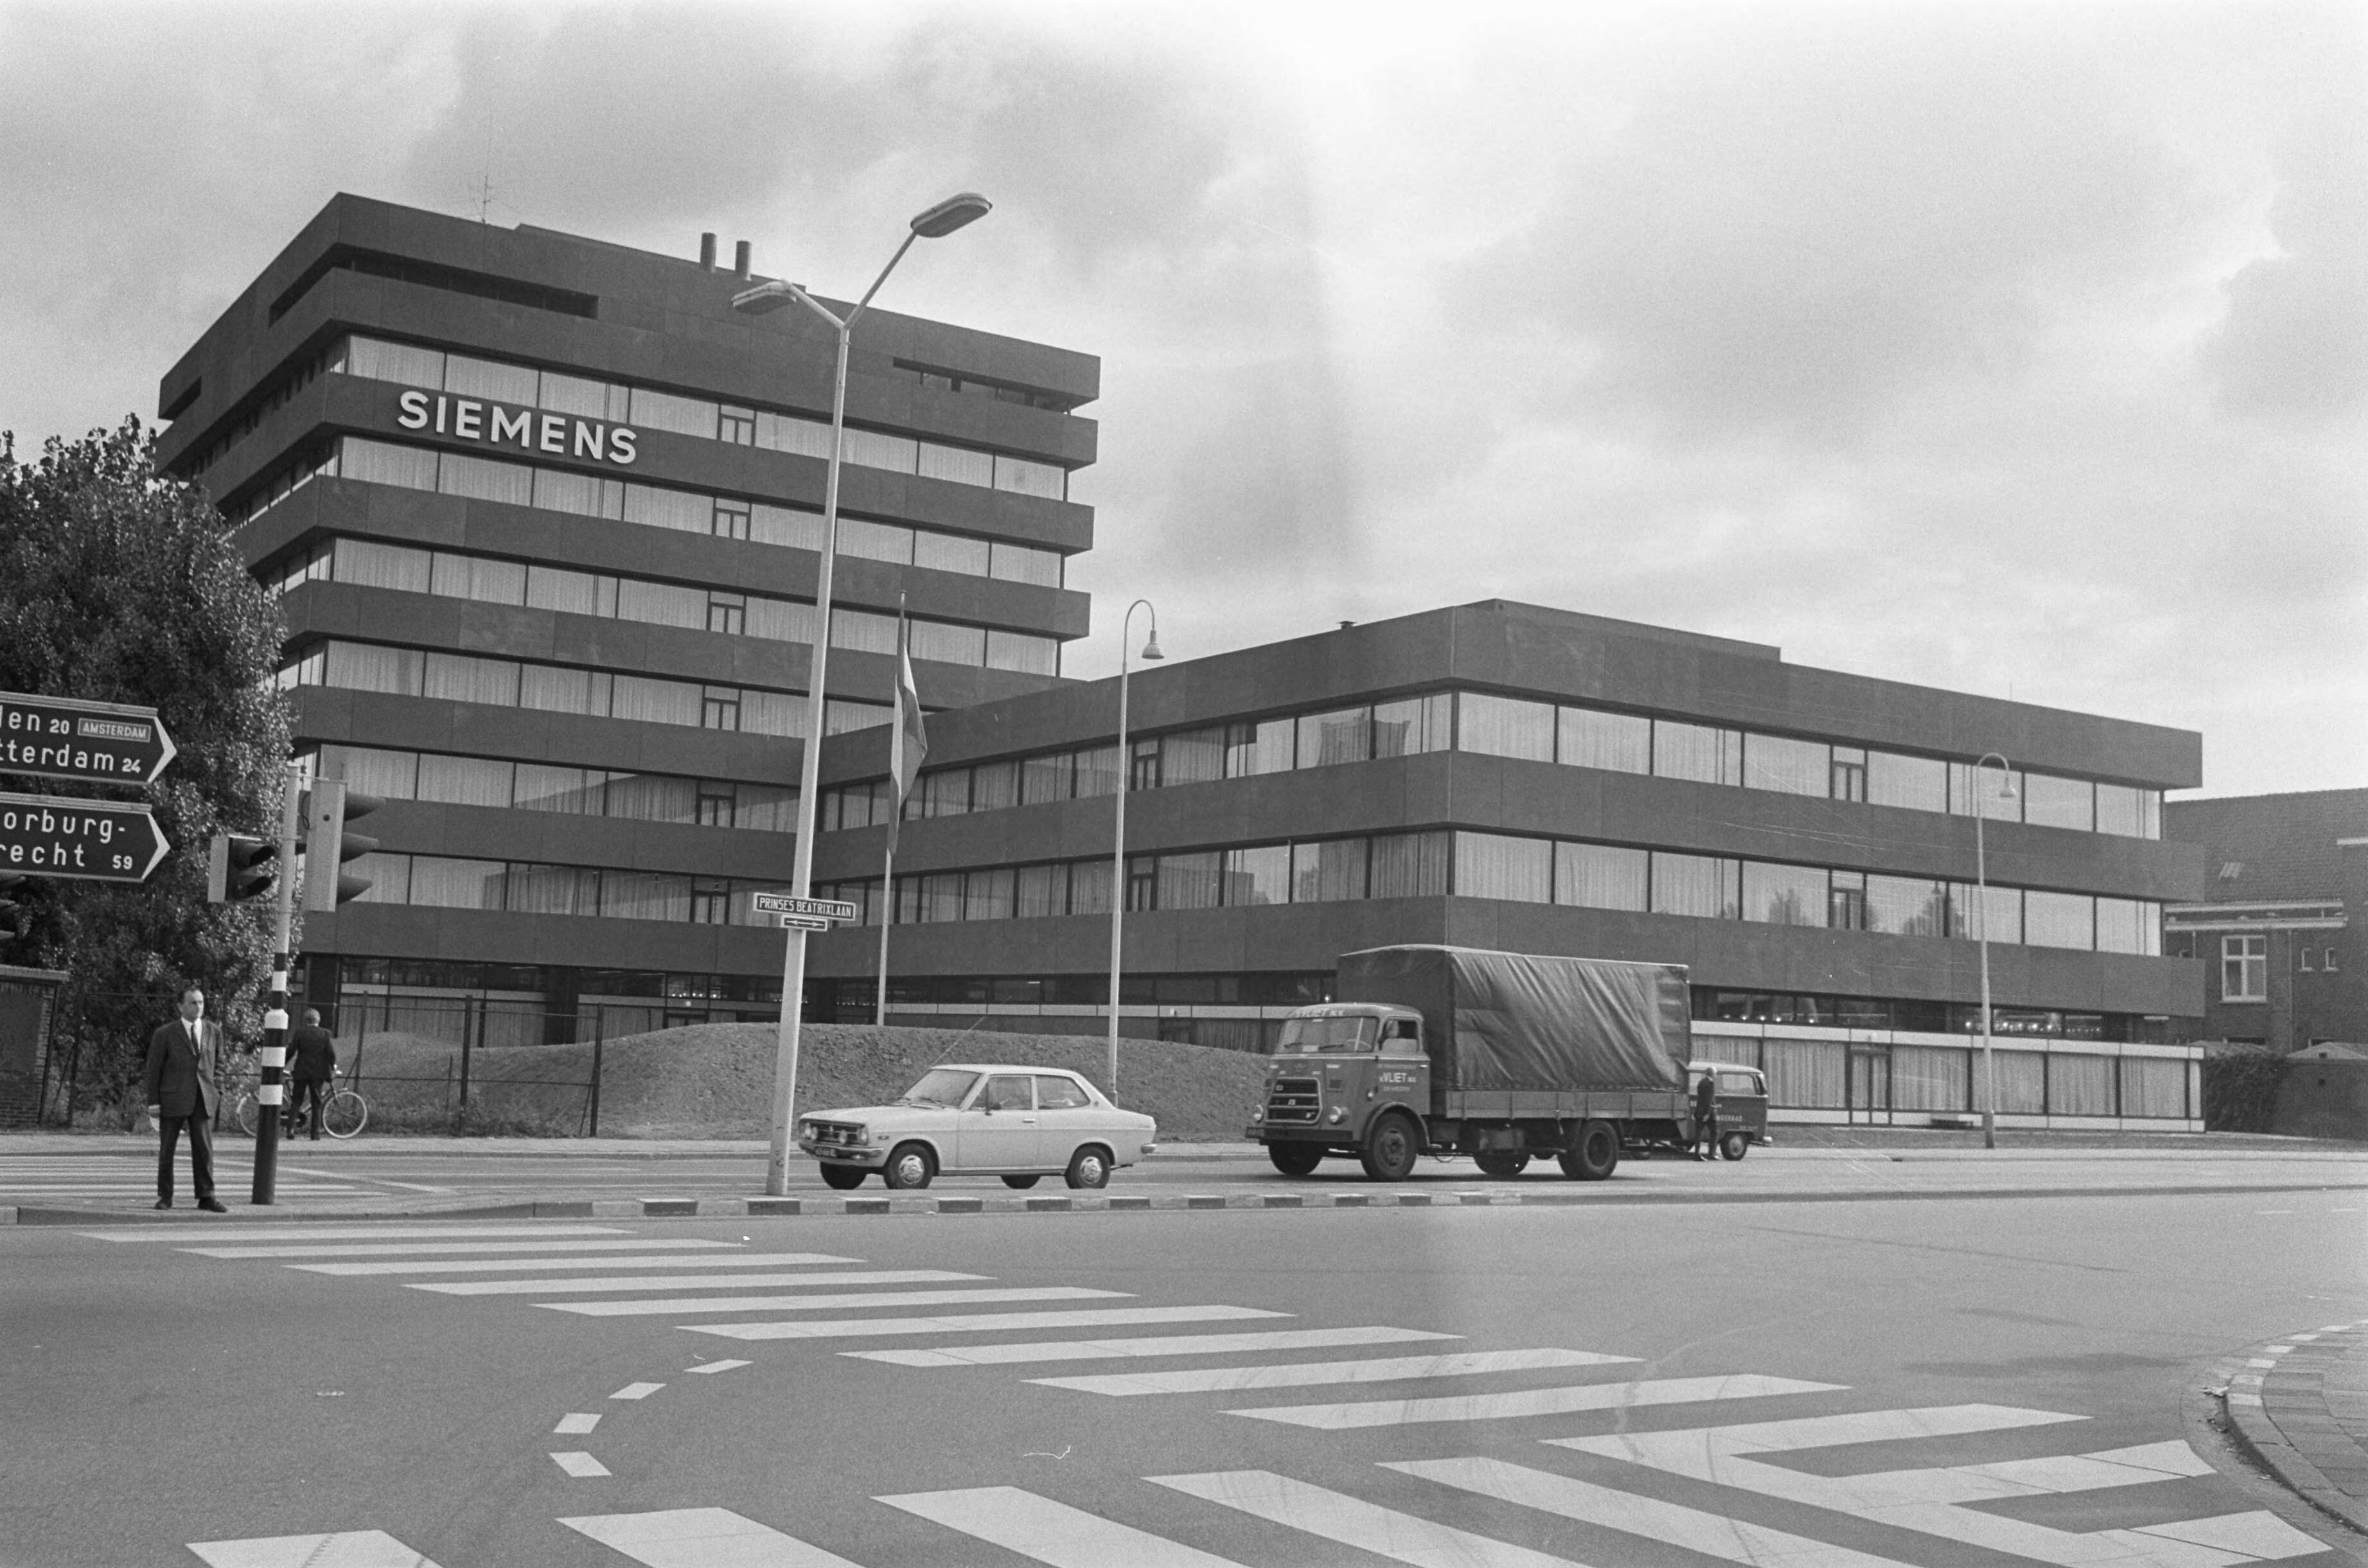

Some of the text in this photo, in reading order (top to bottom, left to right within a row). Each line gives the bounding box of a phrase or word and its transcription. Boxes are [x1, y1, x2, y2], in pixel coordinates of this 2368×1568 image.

[398, 391, 637, 464] SIEMENS
[0, 705, 146, 739] en 20 AMSTERDAM
[0, 739, 141, 773] terdam 24
[112, 854, 132, 870] 59
[759, 897, 851, 917] PRINSES BEATRIXLAAN
